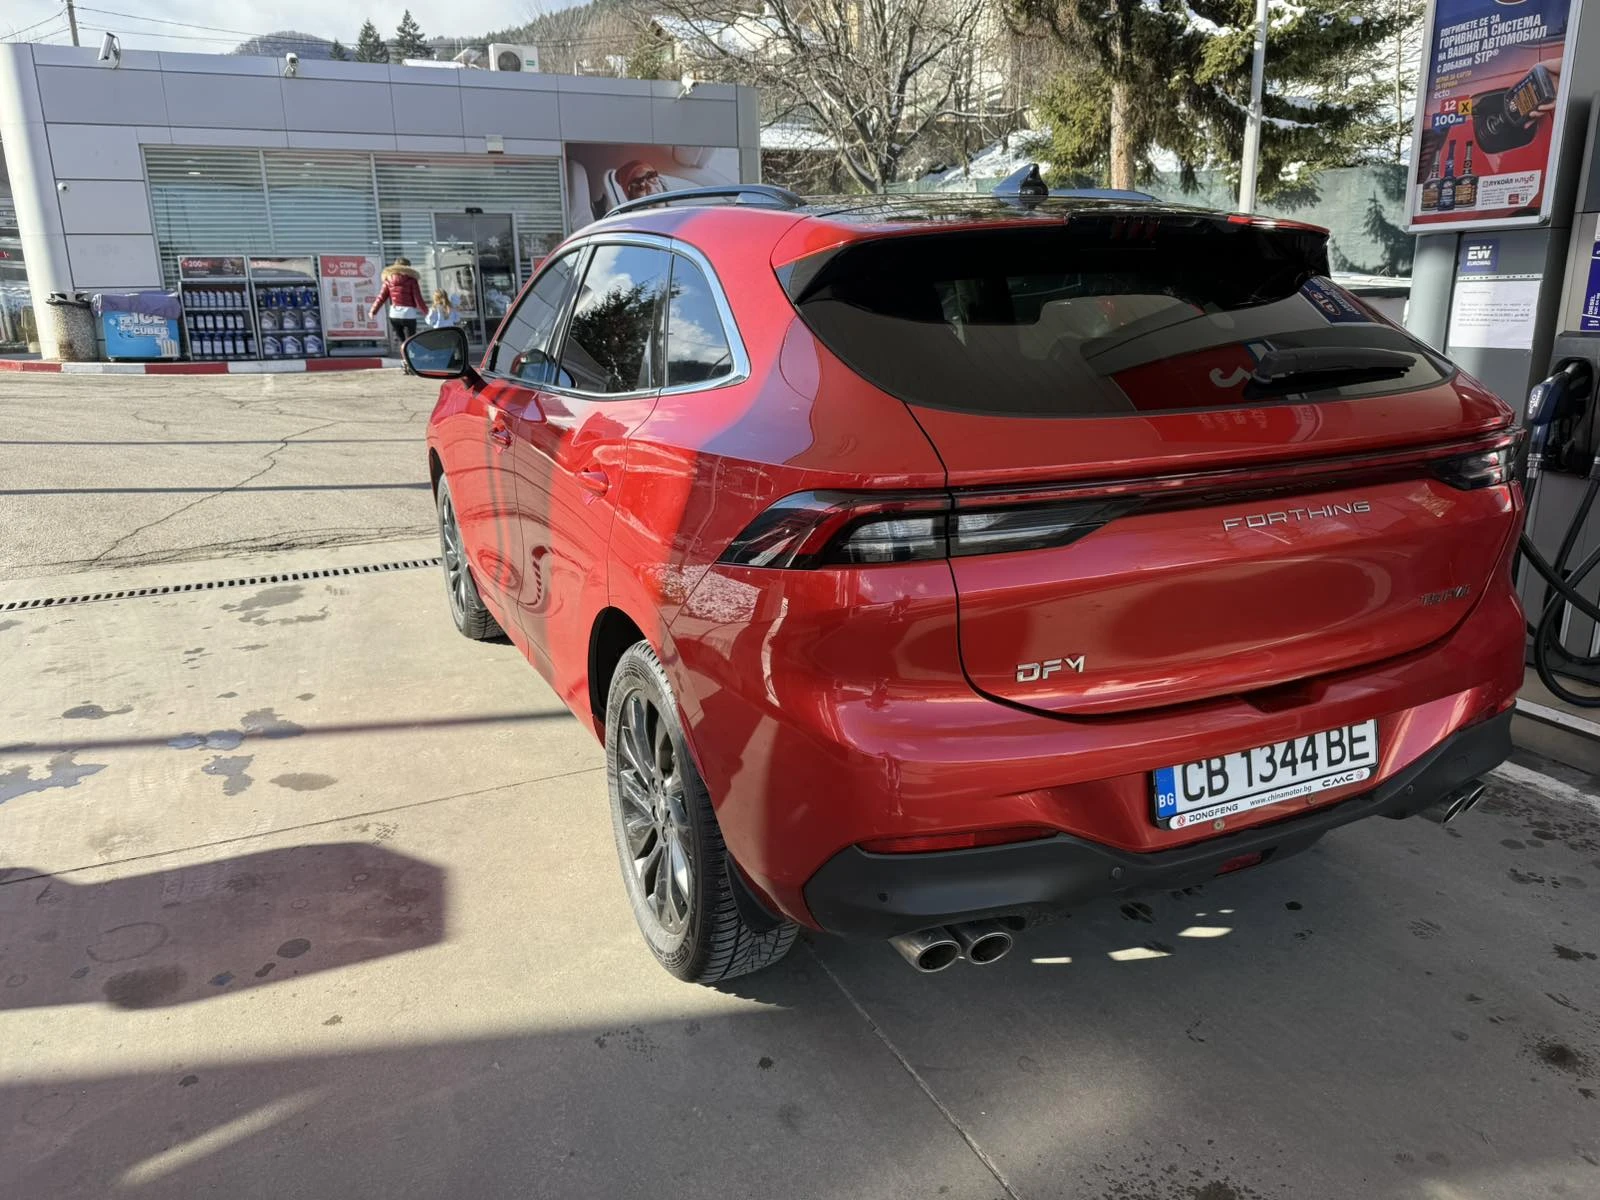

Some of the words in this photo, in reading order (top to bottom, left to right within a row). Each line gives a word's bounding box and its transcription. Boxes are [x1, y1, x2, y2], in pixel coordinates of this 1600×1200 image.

[1439, 28, 1487, 50] ГОРИВНАТА
[1490, 14, 1542, 36] СИСТЕМА
[1479, 17, 1489, 27] СЕ
[1490, 14, 1501, 25] ЗА
[1438, 51, 1447, 61] НА
[1447, 41, 1481, 59] ВАШИЯ
[1481, 26, 1548, 50] АВТОМОБИЛ
[1437, 64, 1442, 73] С
[1442, 57, 1473, 73] ДОБАВКИ
[1444, 100, 1457, 112] 12
[133, 326, 168, 335] CUBES
[1222, 501, 1371, 532] FORTHING
[1016, 655, 1085, 683] DFM
[1181, 757, 1229, 803] CB
[1241, 734, 1319, 788] 1344
[1326, 721, 1370, 767] BE
[1158, 792, 1175, 808] BG
[1188, 803, 1239, 823] DONGFENG
[1249, 784, 1312, 807] www.chinamotor.bg
[1322, 773, 1354, 788] CMC
